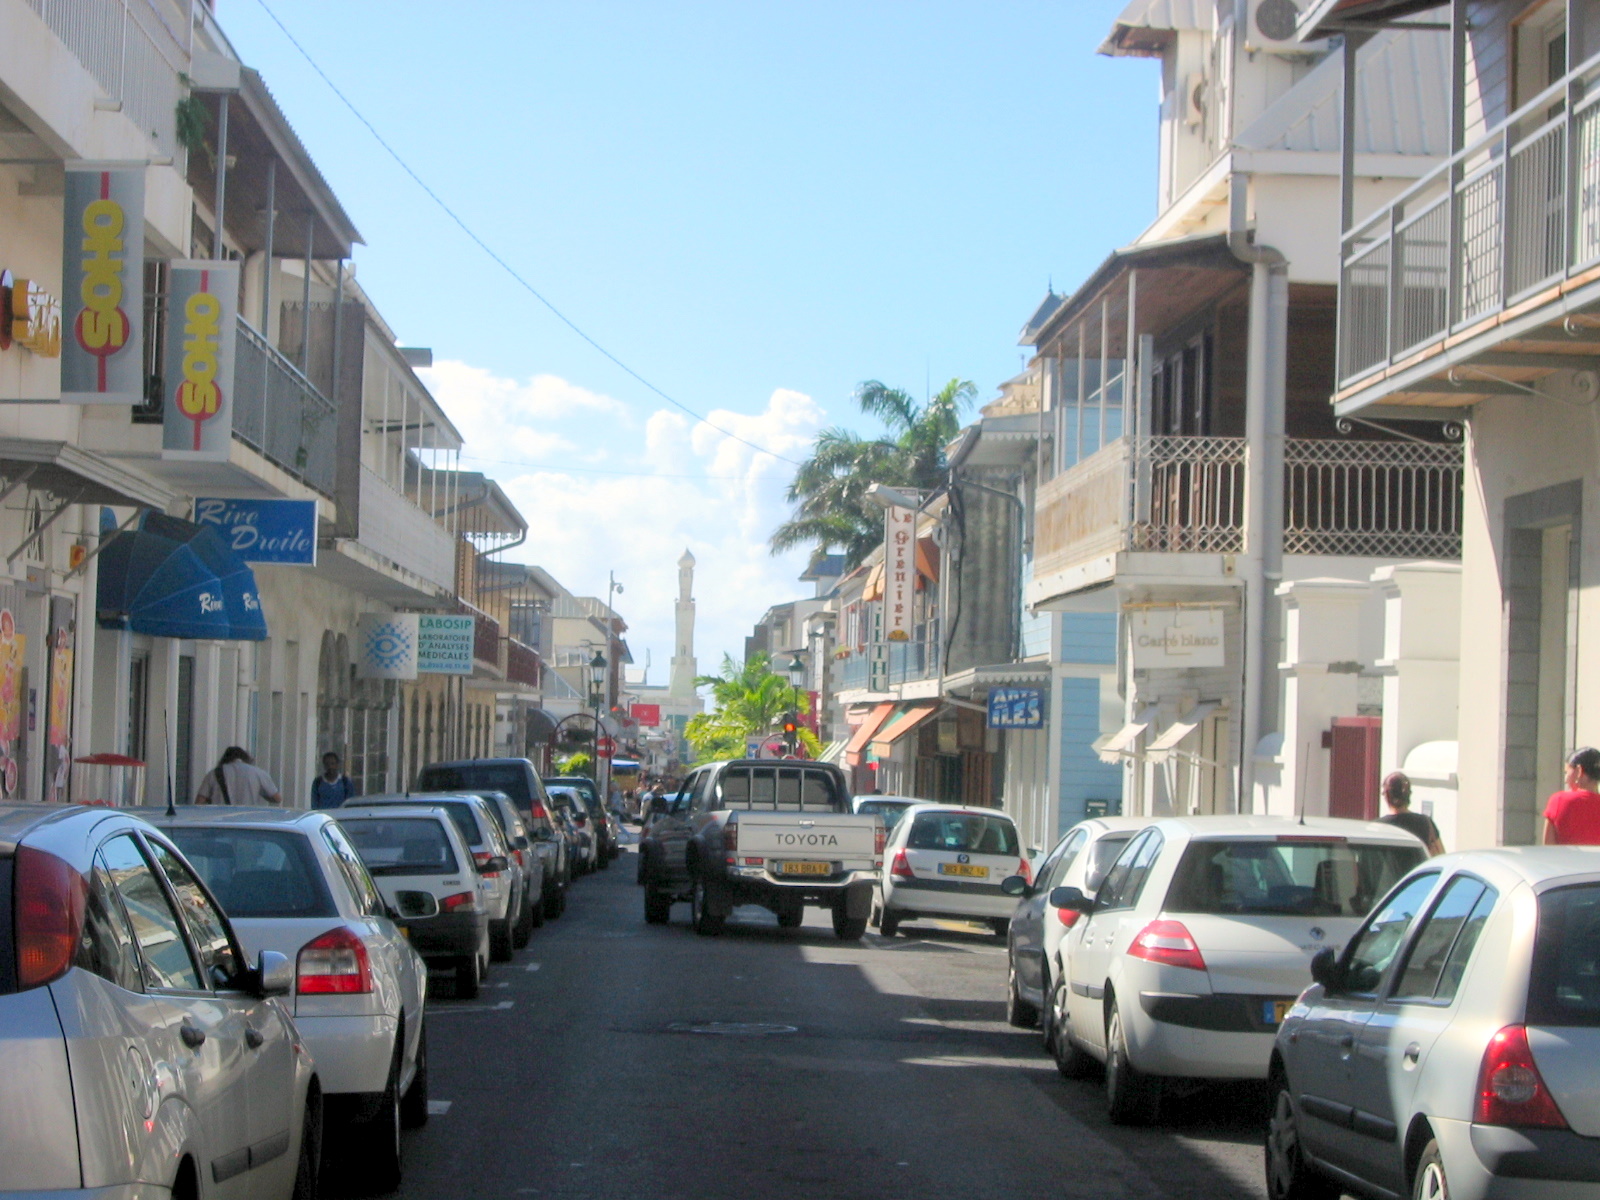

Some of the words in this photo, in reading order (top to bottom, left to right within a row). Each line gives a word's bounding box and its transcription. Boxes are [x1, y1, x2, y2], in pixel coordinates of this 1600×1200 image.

[80, 198, 124, 348] SOHO
[181, 291, 221, 414] SOHO
[198, 500, 258, 525] Rive
[230, 524, 310, 551] Droite
[420, 619, 472, 630] LABOSIP
[418, 634, 470, 642] LABORATOIRE
[428, 642, 469, 651] ANALYSES
[418, 651, 469, 660] MEDICALES
[775, 833, 839, 846] TOYOTA
